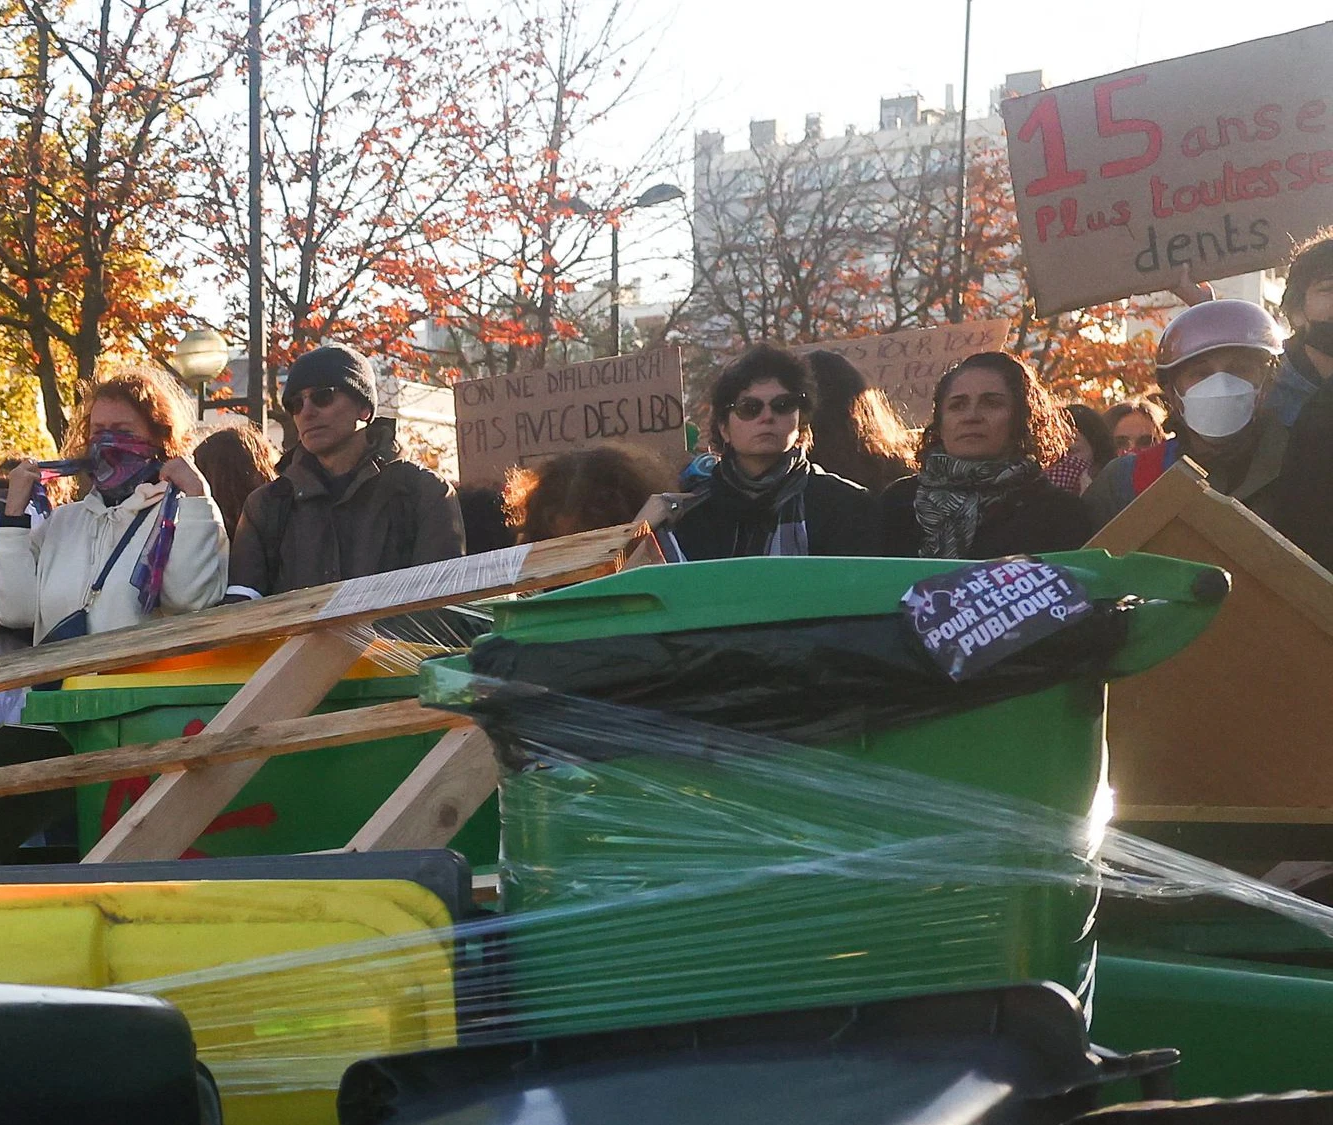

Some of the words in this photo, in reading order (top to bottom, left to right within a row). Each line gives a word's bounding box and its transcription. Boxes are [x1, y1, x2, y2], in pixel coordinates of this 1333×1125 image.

[1017, 73, 1162, 197] 15
[1182, 104, 1282, 157] ans
[1035, 198, 1131, 243] Plus
[1150, 159, 1282, 218] toutes
[1135, 214, 1270, 274] dents
[463, 382, 494, 407] ON
[506, 375, 533, 398] NE
[548, 351, 661, 393] DIALOGUERA
[461, 416, 507, 459] PAS
[515, 404, 576, 449] AVEC
[584, 398, 629, 440] DES
[637, 393, 684, 434] LBD
[926, 607, 981, 648] POUR
[975, 565, 1058, 616] L'ÉCOLE
[957, 585, 1063, 657] PUBLIQUE
